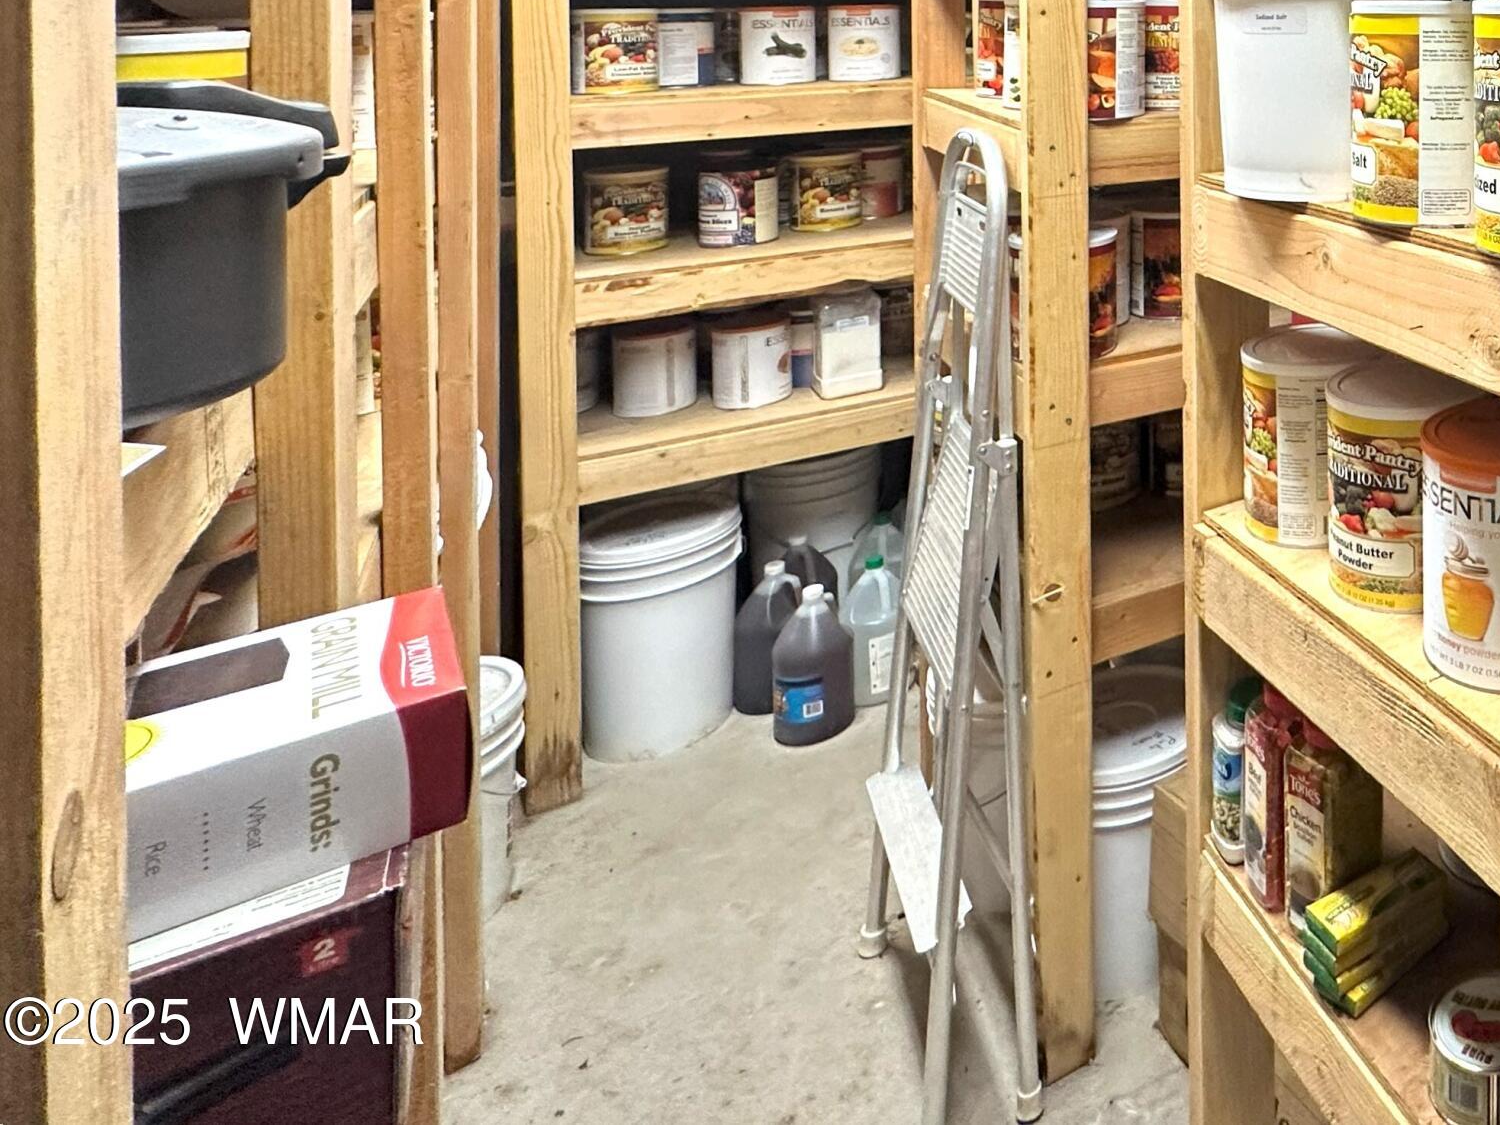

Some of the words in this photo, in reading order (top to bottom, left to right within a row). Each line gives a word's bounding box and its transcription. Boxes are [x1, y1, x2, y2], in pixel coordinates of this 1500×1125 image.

[1364, 443, 1423, 478] Pantry
[1338, 549, 1374, 571] Powder
[1356, 544, 1394, 560] Butter
[406, 635, 436, 688] VICTORIO
[1463, 644, 1500, 660] powder
[309, 752, 341, 854] Grinds:
[247, 797, 267, 852] Wheat
[1290, 804, 1322, 834] Chicken
[145, 840, 167, 877] Rice
[312, 937, 336, 961] 2
[1460, 1043, 1494, 1065] PURE
